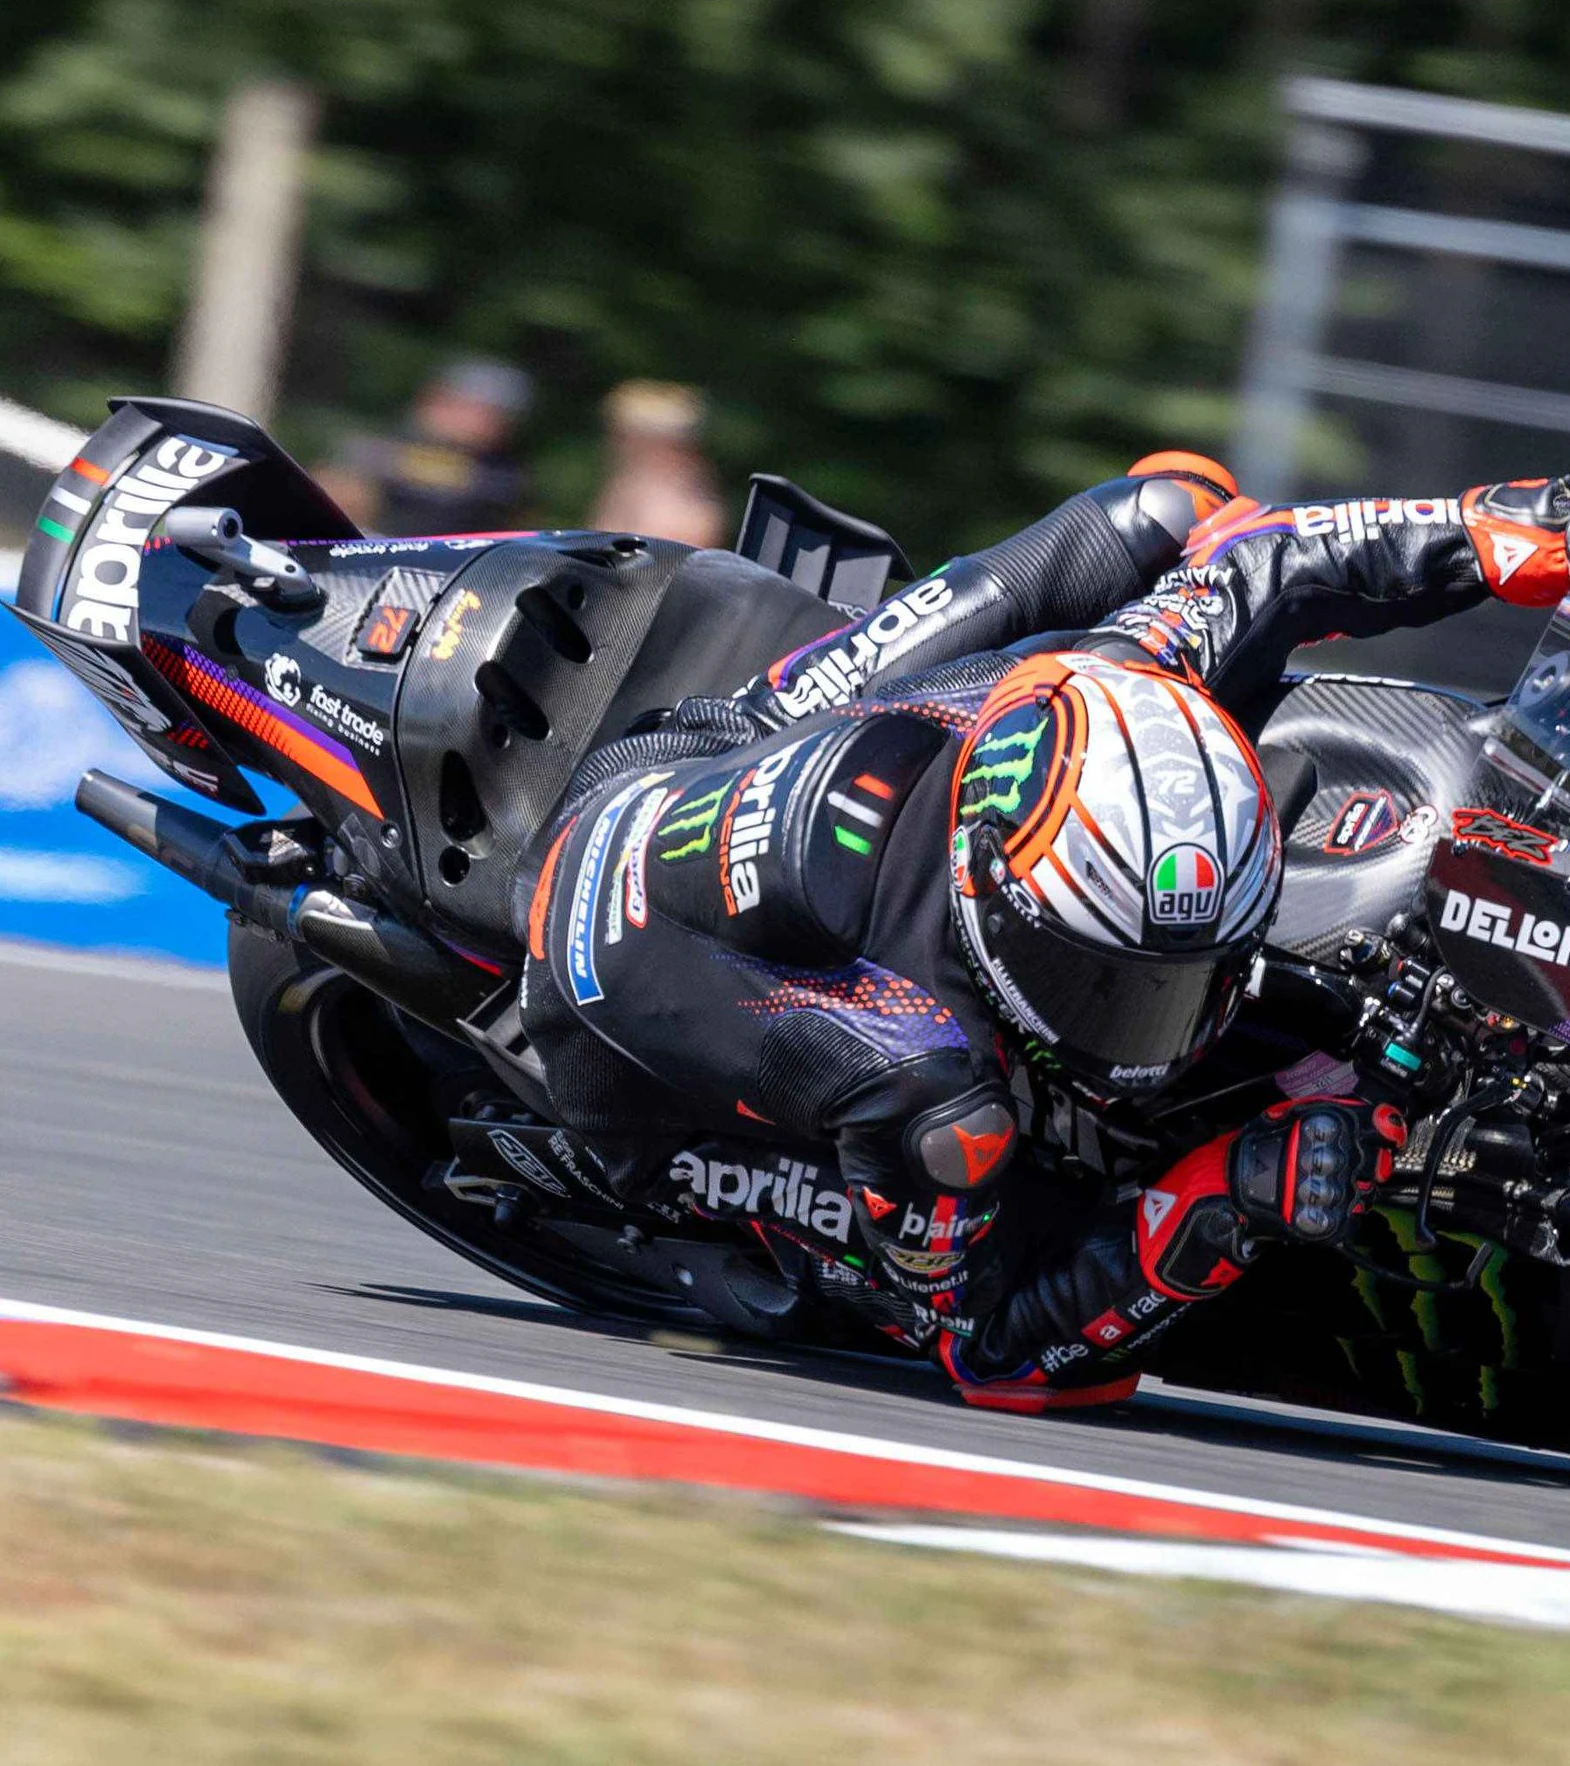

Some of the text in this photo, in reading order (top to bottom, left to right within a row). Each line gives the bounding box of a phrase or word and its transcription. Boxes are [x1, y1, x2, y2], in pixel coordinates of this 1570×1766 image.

[67, 436, 226, 642] aprilia
[774, 577, 954, 718] aprilia
[310, 684, 384, 746] fast trade
[740, 731, 823, 913] prilia
[1152, 769, 1198, 796] 72
[574, 815, 612, 978] MICHELIN
[1158, 892, 1213, 921] agv
[669, 1150, 853, 1244] aprilia
